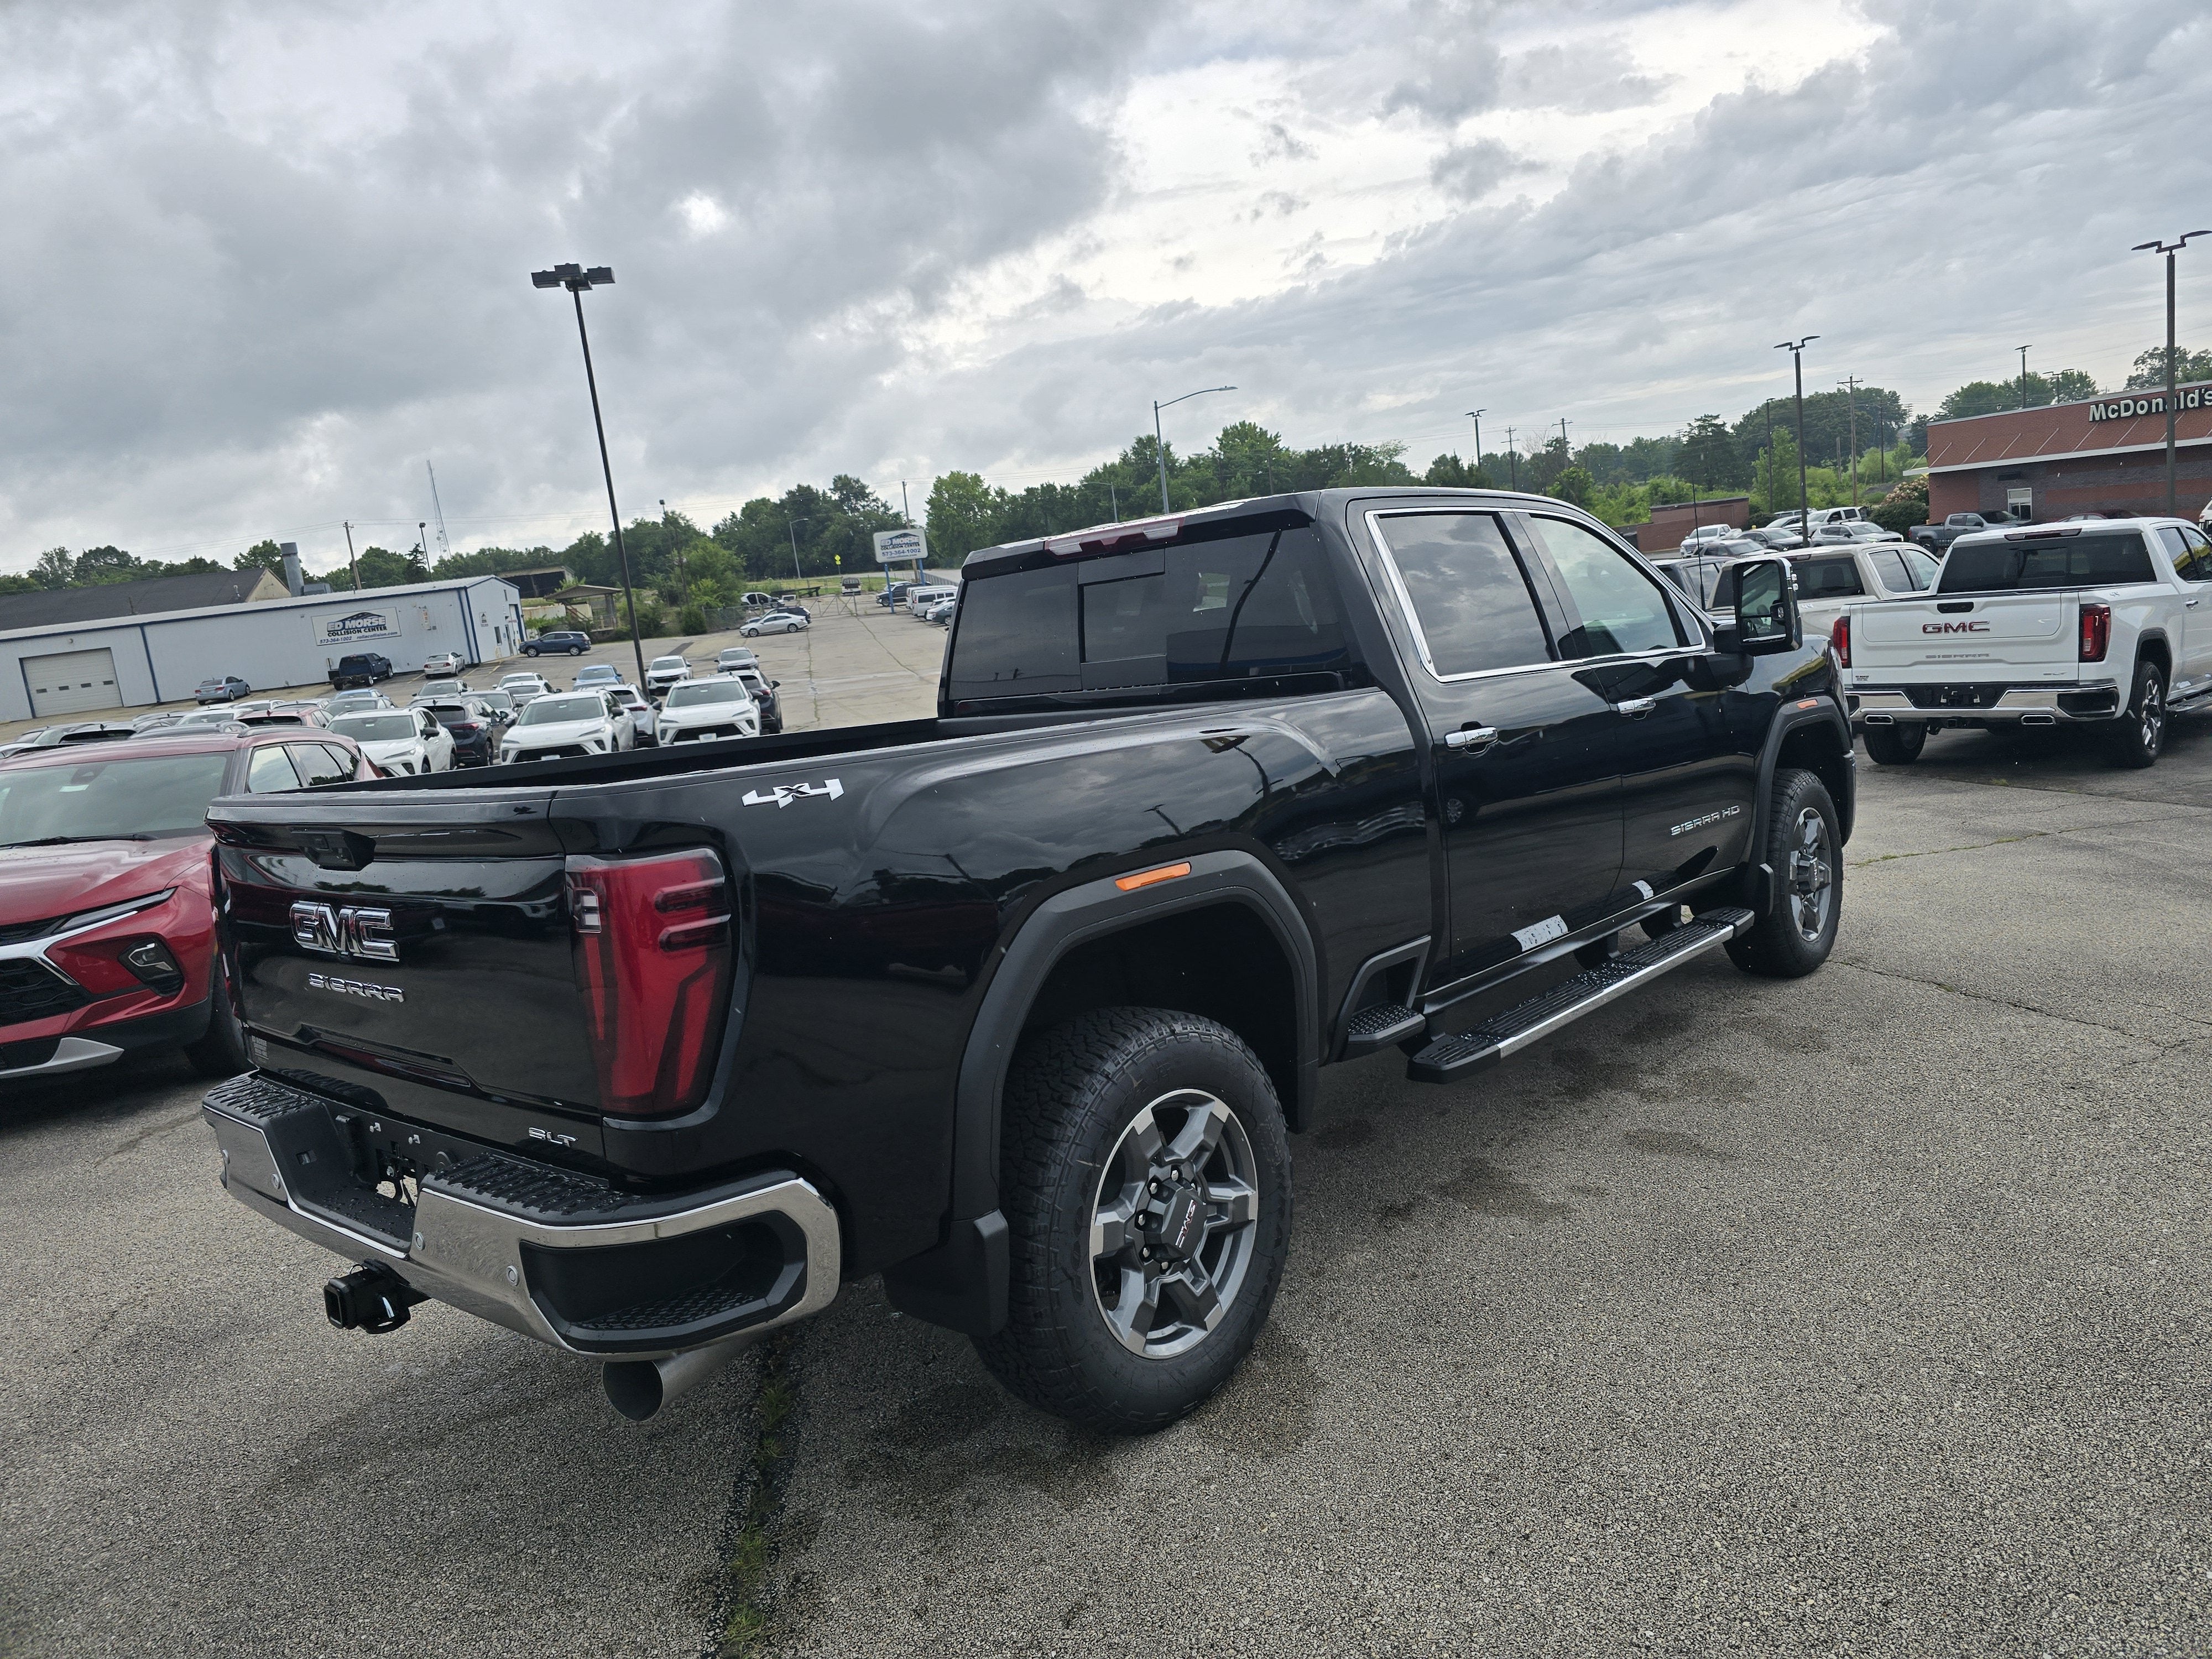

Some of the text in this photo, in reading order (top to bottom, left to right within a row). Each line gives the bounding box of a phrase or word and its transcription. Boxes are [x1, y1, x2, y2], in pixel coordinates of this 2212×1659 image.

[2089, 388, 2212, 421] McDonld's
[882, 548, 921, 557] 573-364-1002
[327, 616, 385, 632] ED MORSE
[327, 629, 362, 637] COLLISION
[1922, 620, 1990, 634] GMC
[320, 636, 352, 644] 573-364-1002
[1670, 805, 1740, 836] SIERRA HD
[289, 900, 400, 962] GMC
[309, 972, 405, 1003] SIERRA
[528, 1127, 578, 1147] SLT
